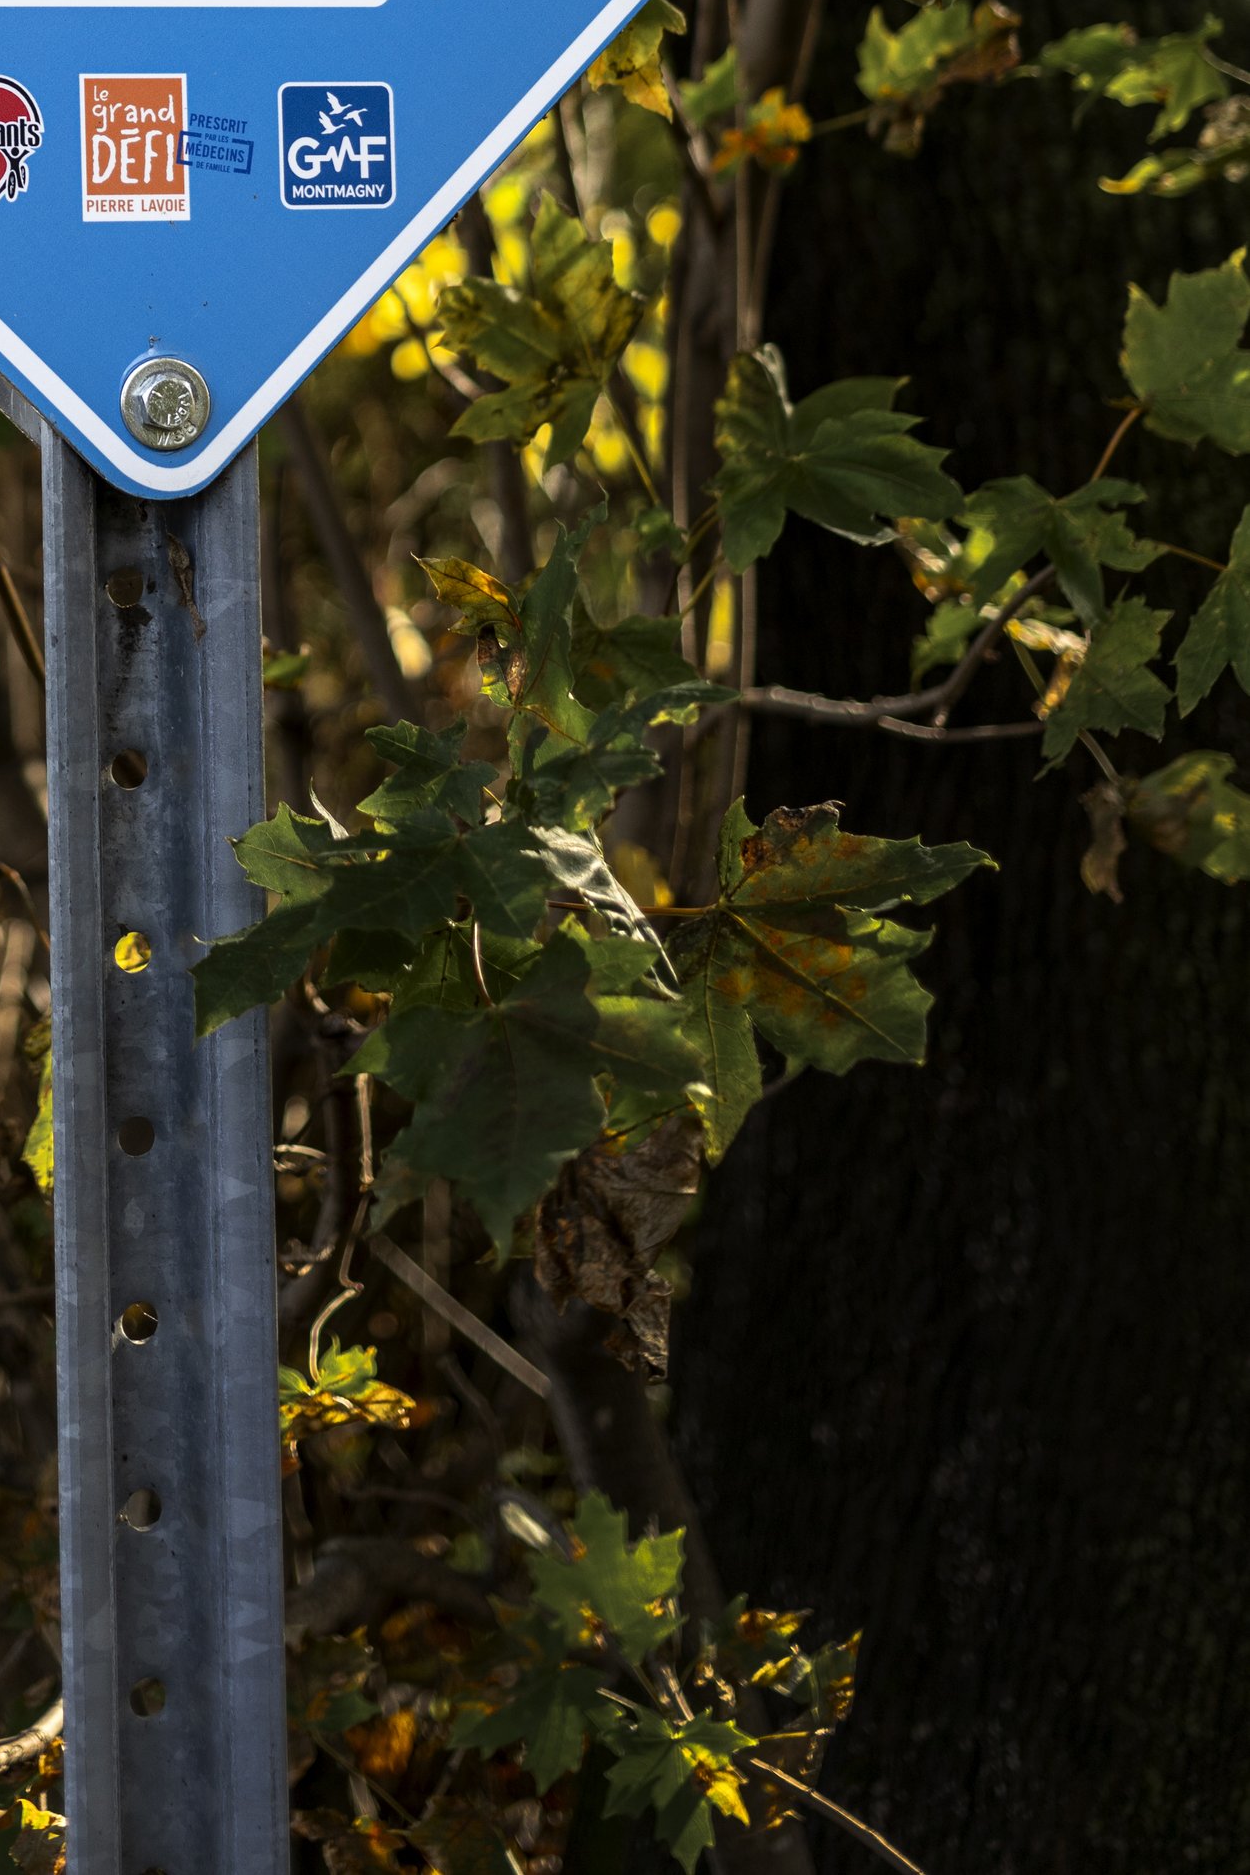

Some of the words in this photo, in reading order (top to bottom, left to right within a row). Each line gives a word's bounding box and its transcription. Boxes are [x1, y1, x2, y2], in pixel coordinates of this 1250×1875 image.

[93, 85, 109, 102] le
[92, 94, 176, 133] grand
[189, 113, 248, 134] PRESCRIT
[204, 133, 217, 142] PAR
[218, 134, 229, 143] LES
[92, 127, 174, 184] DÉFI
[185, 140, 245, 163] MÉDECINS
[195, 161, 205, 170] DE
[205, 162, 231, 173] FAMILLE
[292, 184, 385, 199] MONTMAGNY
[86, 199, 135, 213] PIERRE
[141, 199, 186, 212] LAVOIE
